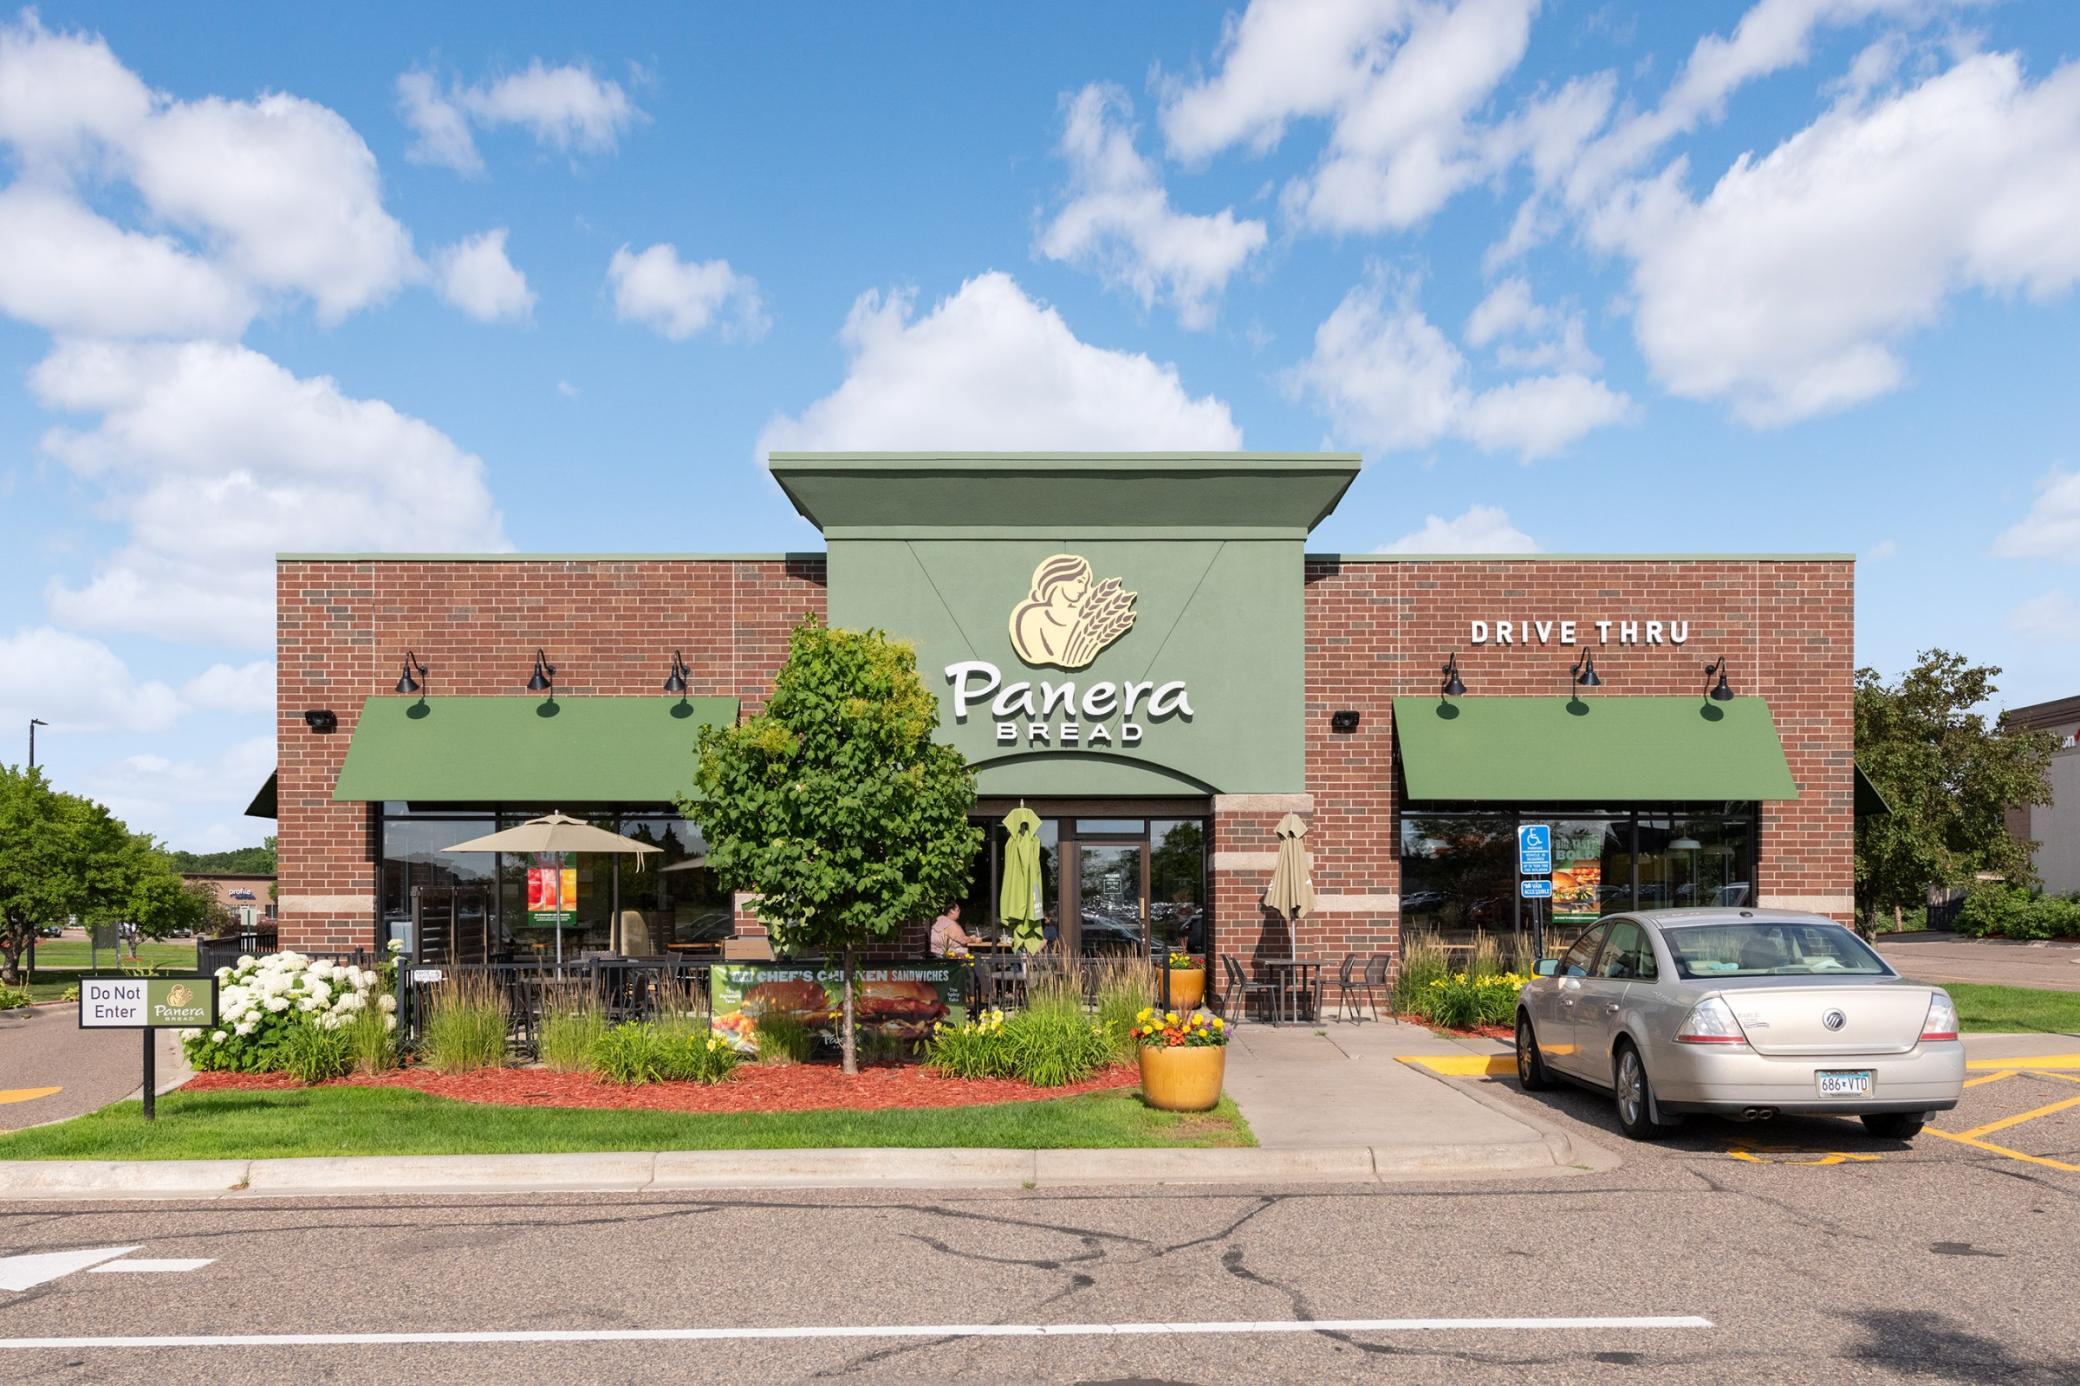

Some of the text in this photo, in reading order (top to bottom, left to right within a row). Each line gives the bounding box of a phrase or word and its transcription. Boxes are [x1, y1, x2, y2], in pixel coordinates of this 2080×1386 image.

[1471, 620, 1689, 644] DRIVE THRU
[944, 660, 1195, 718] Panera
[996, 722, 1143, 742] BREAD
[228, 887, 252, 896] profile
[757, 970, 814, 982] CHEF'S
[891, 969, 950, 982] SANDWICHES
[90, 986, 141, 1000] Do Not
[95, 1004, 137, 1019] Enter
[153, 1004, 206, 1017] Panera
[1822, 1077, 1841, 1091] 686
